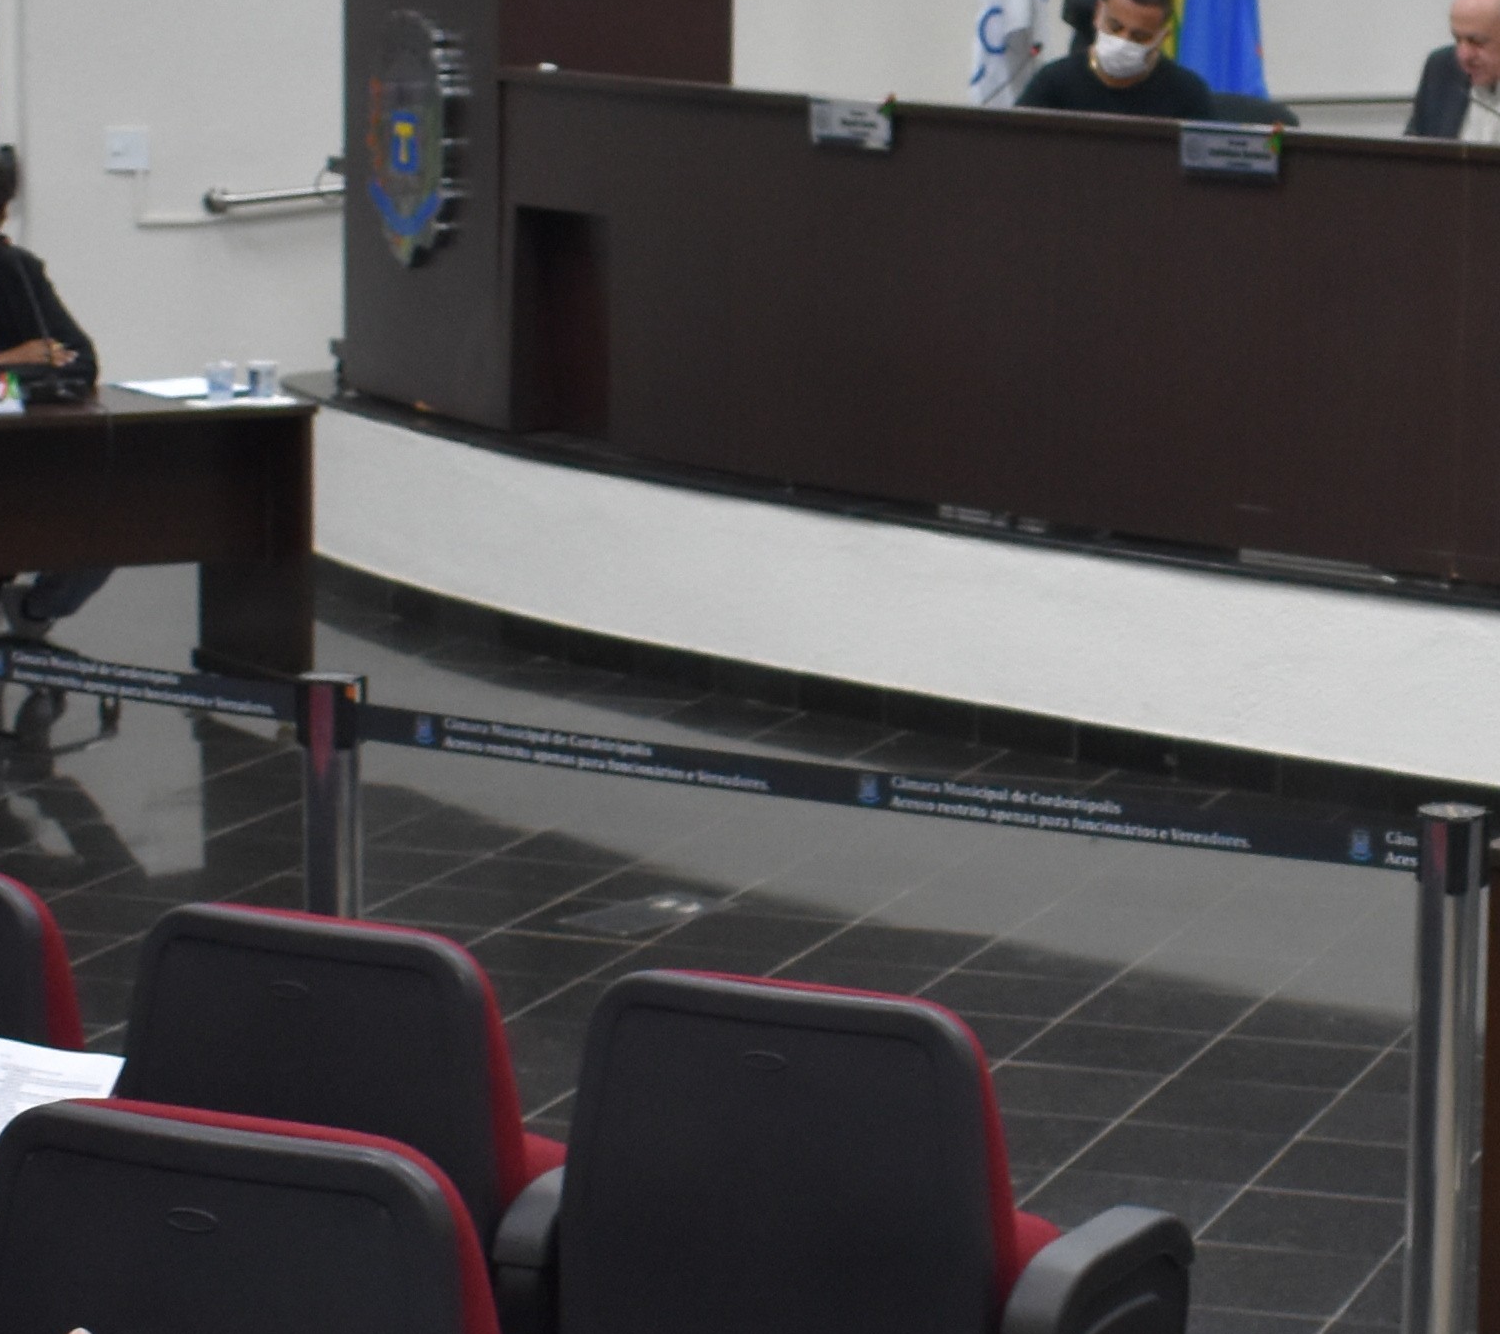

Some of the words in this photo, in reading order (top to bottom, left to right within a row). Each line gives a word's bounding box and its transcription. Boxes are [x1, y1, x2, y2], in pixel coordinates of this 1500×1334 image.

[891, 776, 941, 793] Câmara
[943, 782, 1009, 803] Municipal
[1011, 790, 1028, 803] de
